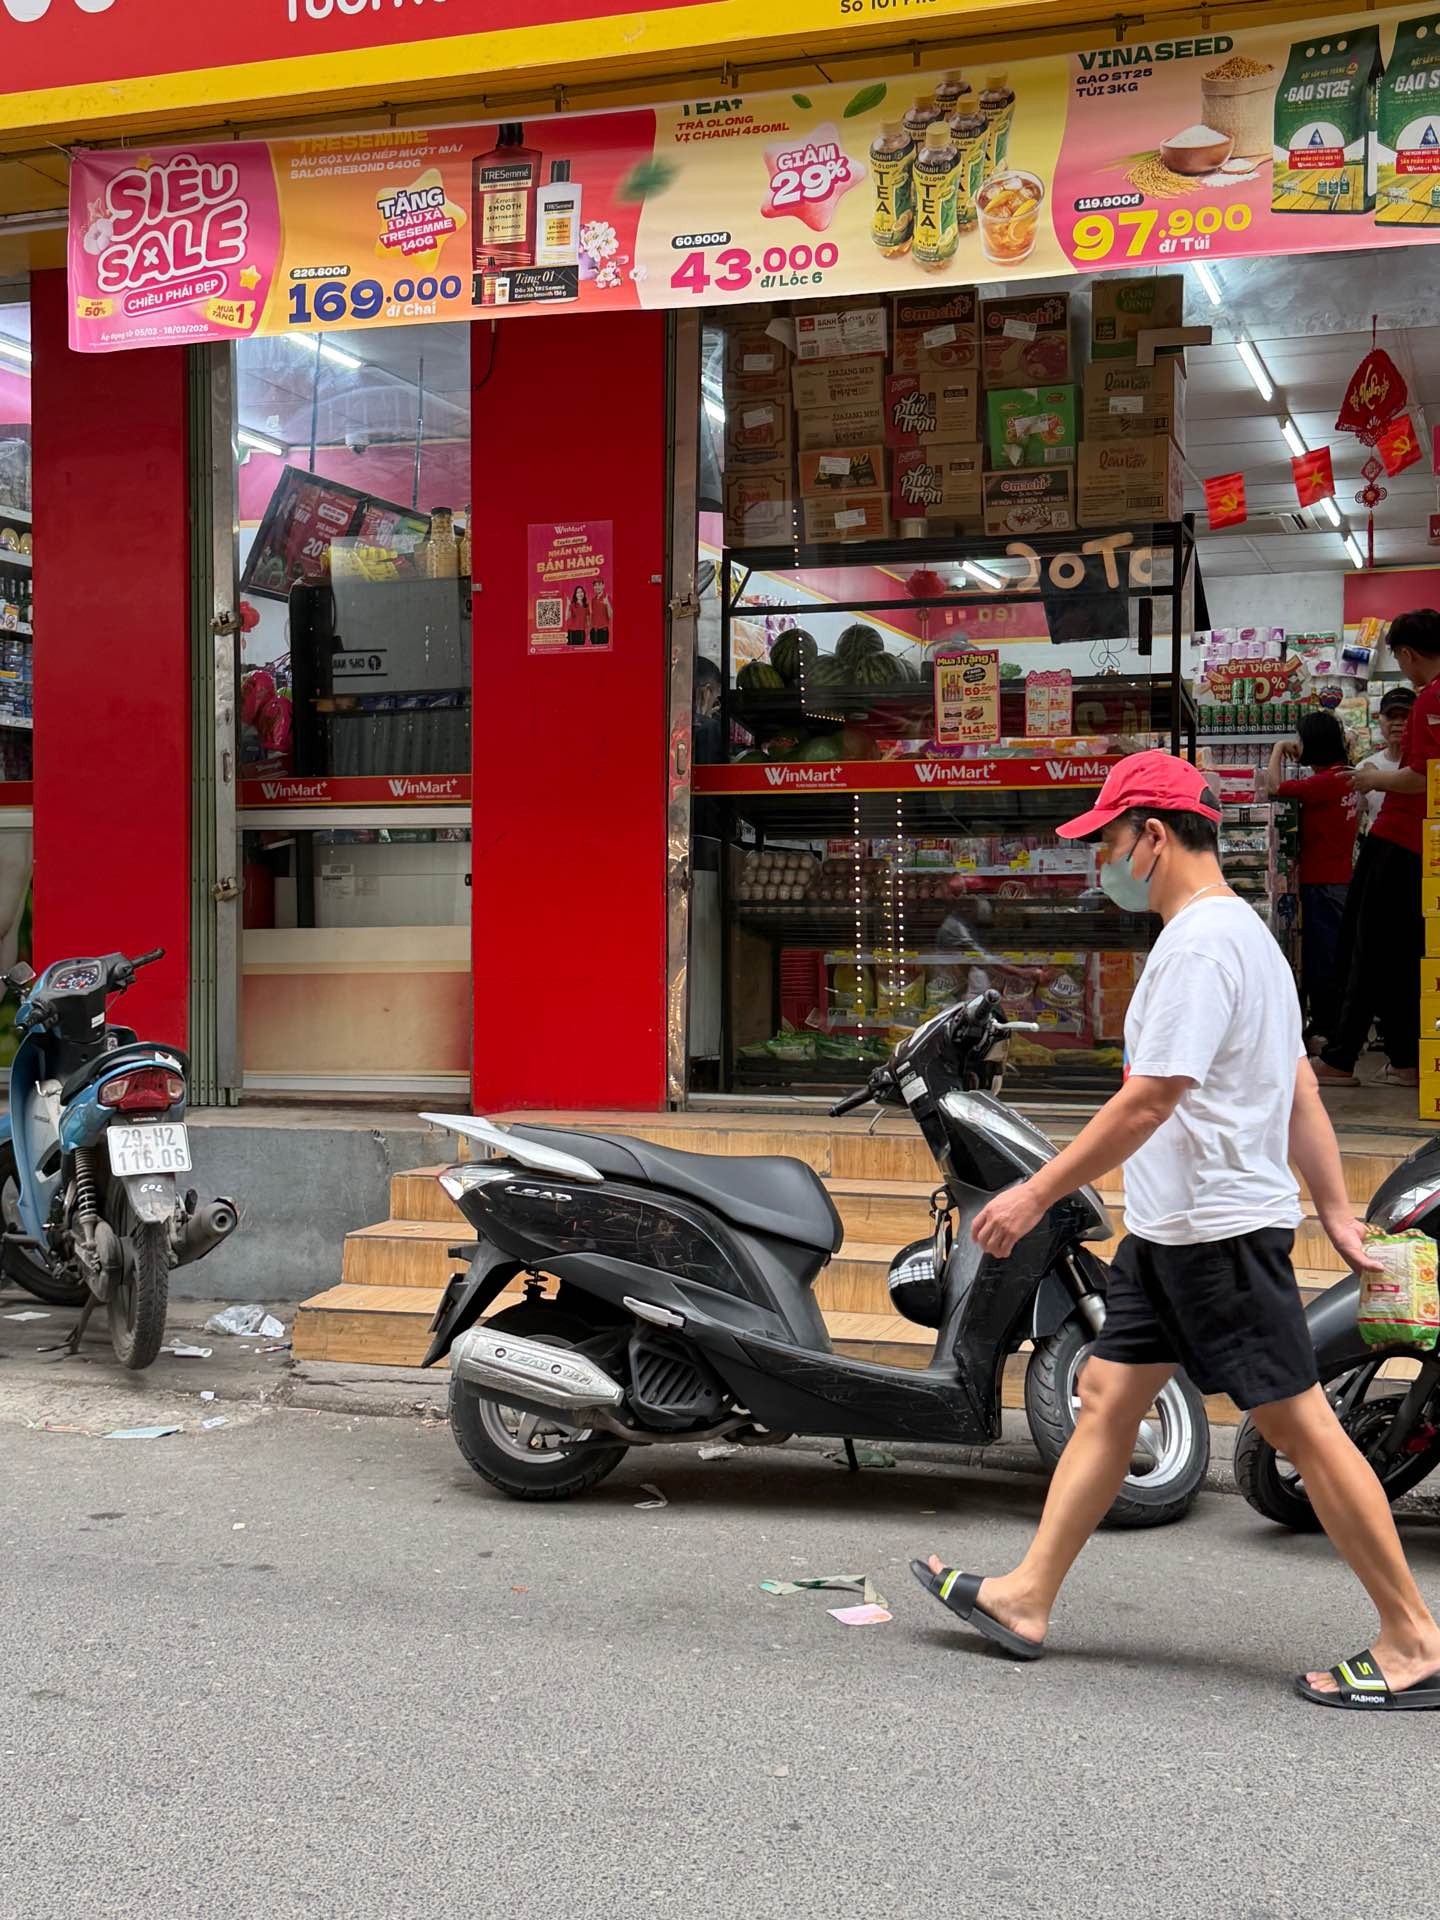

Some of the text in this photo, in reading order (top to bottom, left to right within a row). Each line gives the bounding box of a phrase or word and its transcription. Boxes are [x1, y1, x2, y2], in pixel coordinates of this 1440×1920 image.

[1078, 36, 1234, 70] VINASEED
[1111, 68, 1153, 82] ST25
[1394, 72, 1426, 95] GẠO
[1107, 82, 1138, 94] 3KG
[1288, 84, 1314, 105] GẠO
[1316, 79, 1350, 100] ST25
[693, 127, 741, 141] CHANH
[742, 122, 790, 135] 450ML
[299, 131, 429, 153] TRESEMME
[290, 158, 421, 179] SALON REBOND 640G
[485, 170, 529, 180] TRESemmé
[771, 157, 847, 206] 29%
[105, 153, 239, 241] SIÊU
[874, 169, 891, 215] TEA
[1078, 194, 1140, 210] 119.900đ
[379, 187, 444, 218] TẶNG
[488, 204, 522, 213] SMOOTH
[919, 183, 936, 229] TEA
[381, 219, 453, 244] TRESEMME
[388, 221, 396, 231] 1
[1072, 203, 1252, 261] 97.900
[97, 198, 248, 292] SALE
[402, 235, 434, 251] 140G
[675, 232, 728, 247] 60.900đ
[1181, 234, 1211, 252] Túi
[542, 270, 555, 282] 01
[671, 242, 839, 294] 43.000
[779, 270, 808, 287] Lốc
[811, 271, 823, 284] 6
[128, 278, 219, 310] CHIỀU PHÁI ĐẸP
[289, 275, 462, 324] 169.000
[217, 303, 234, 314] MUA
[235, 303, 245, 324] 1
[403, 302, 437, 316] Chai
[135, 327, 157, 337] 05/03
[164, 324, 208, 335] 18/03/2026
[537, 554, 605, 573] BÁN HÀNG
[936, 656, 956, 666] Mua
[962, 653, 989, 667] Tặng
[764, 765, 843, 786] WinMart+
[914, 762, 997, 783] WinMart+
[261, 781, 328, 800] WinMart+
[387, 778, 459, 797] WinMart+
[121, 1127, 176, 1148] 29-H2
[118, 1148, 185, 1171] 116.06
[504, 1185, 572, 1202] LEAD
[1350, 1694, 1385, 1704] FASHION
